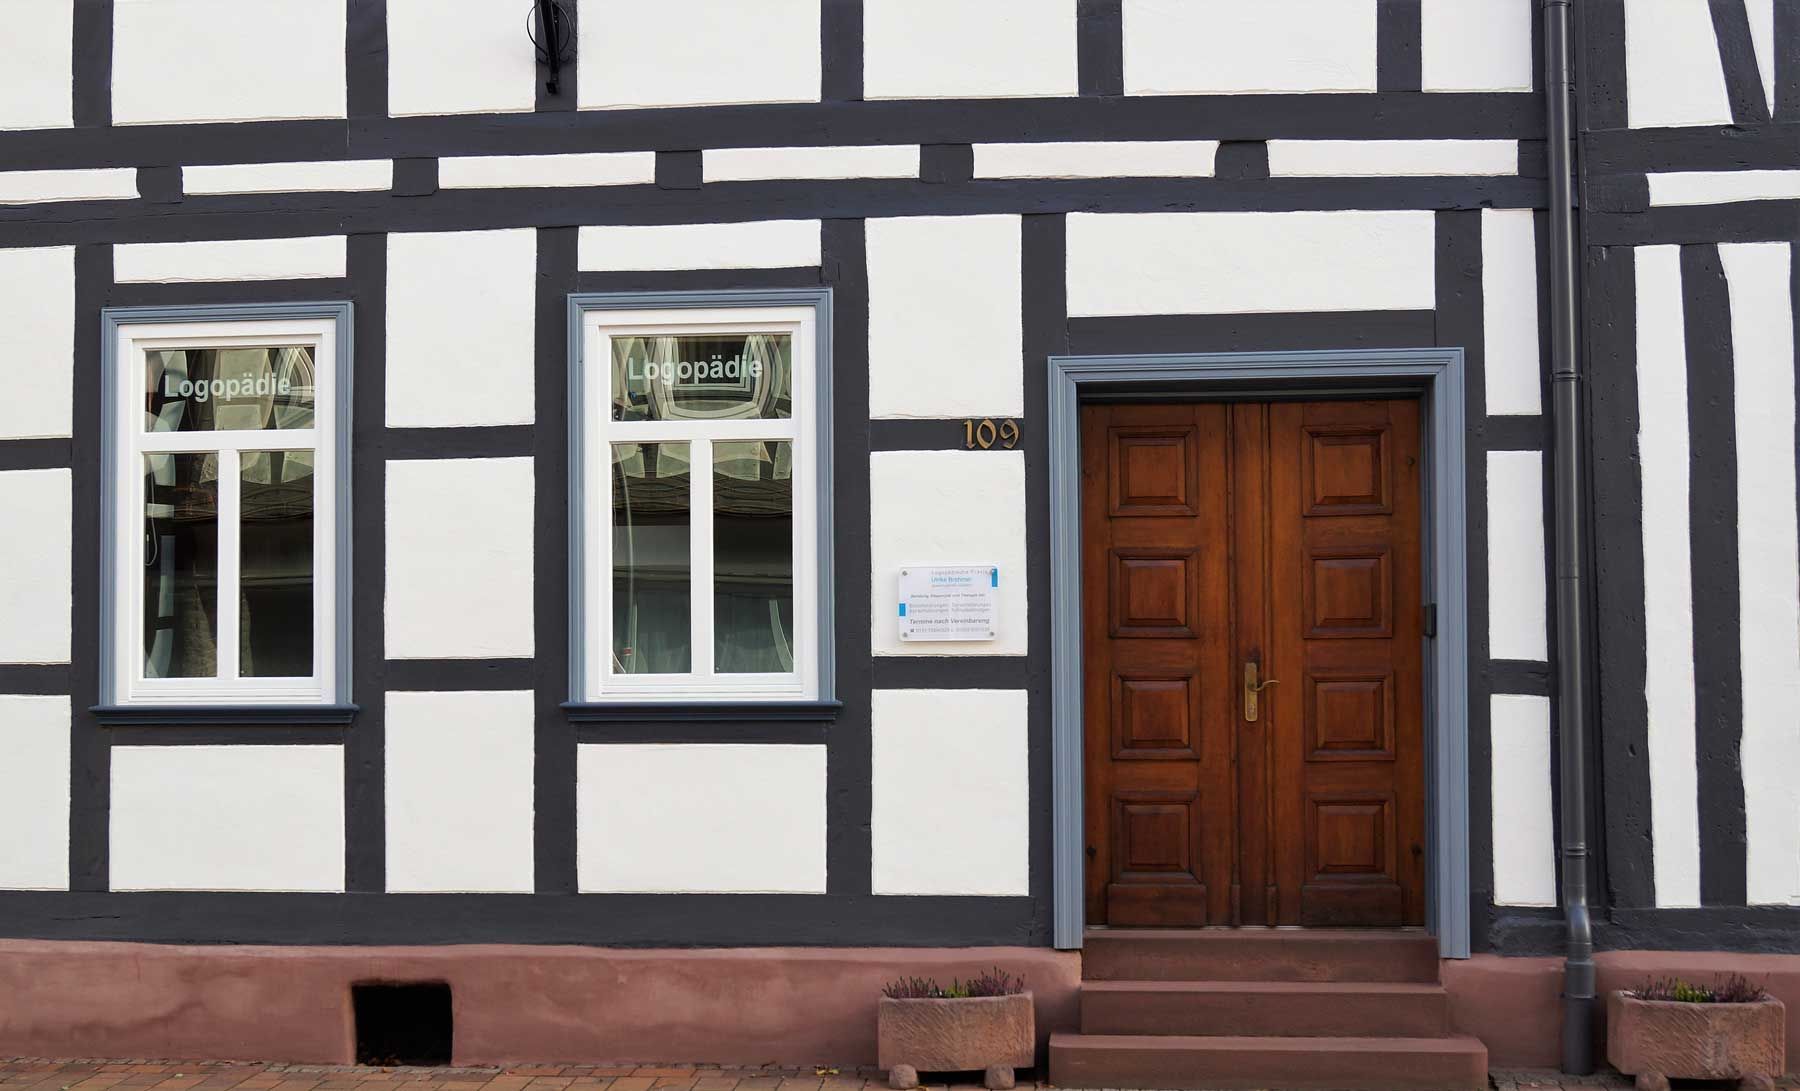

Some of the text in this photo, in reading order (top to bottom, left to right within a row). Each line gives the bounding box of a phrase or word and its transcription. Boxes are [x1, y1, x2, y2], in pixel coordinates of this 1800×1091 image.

[628, 354, 763, 386] Logopädie
[164, 372, 292, 402] Logopädie
[964, 417, 1019, 449] 109
